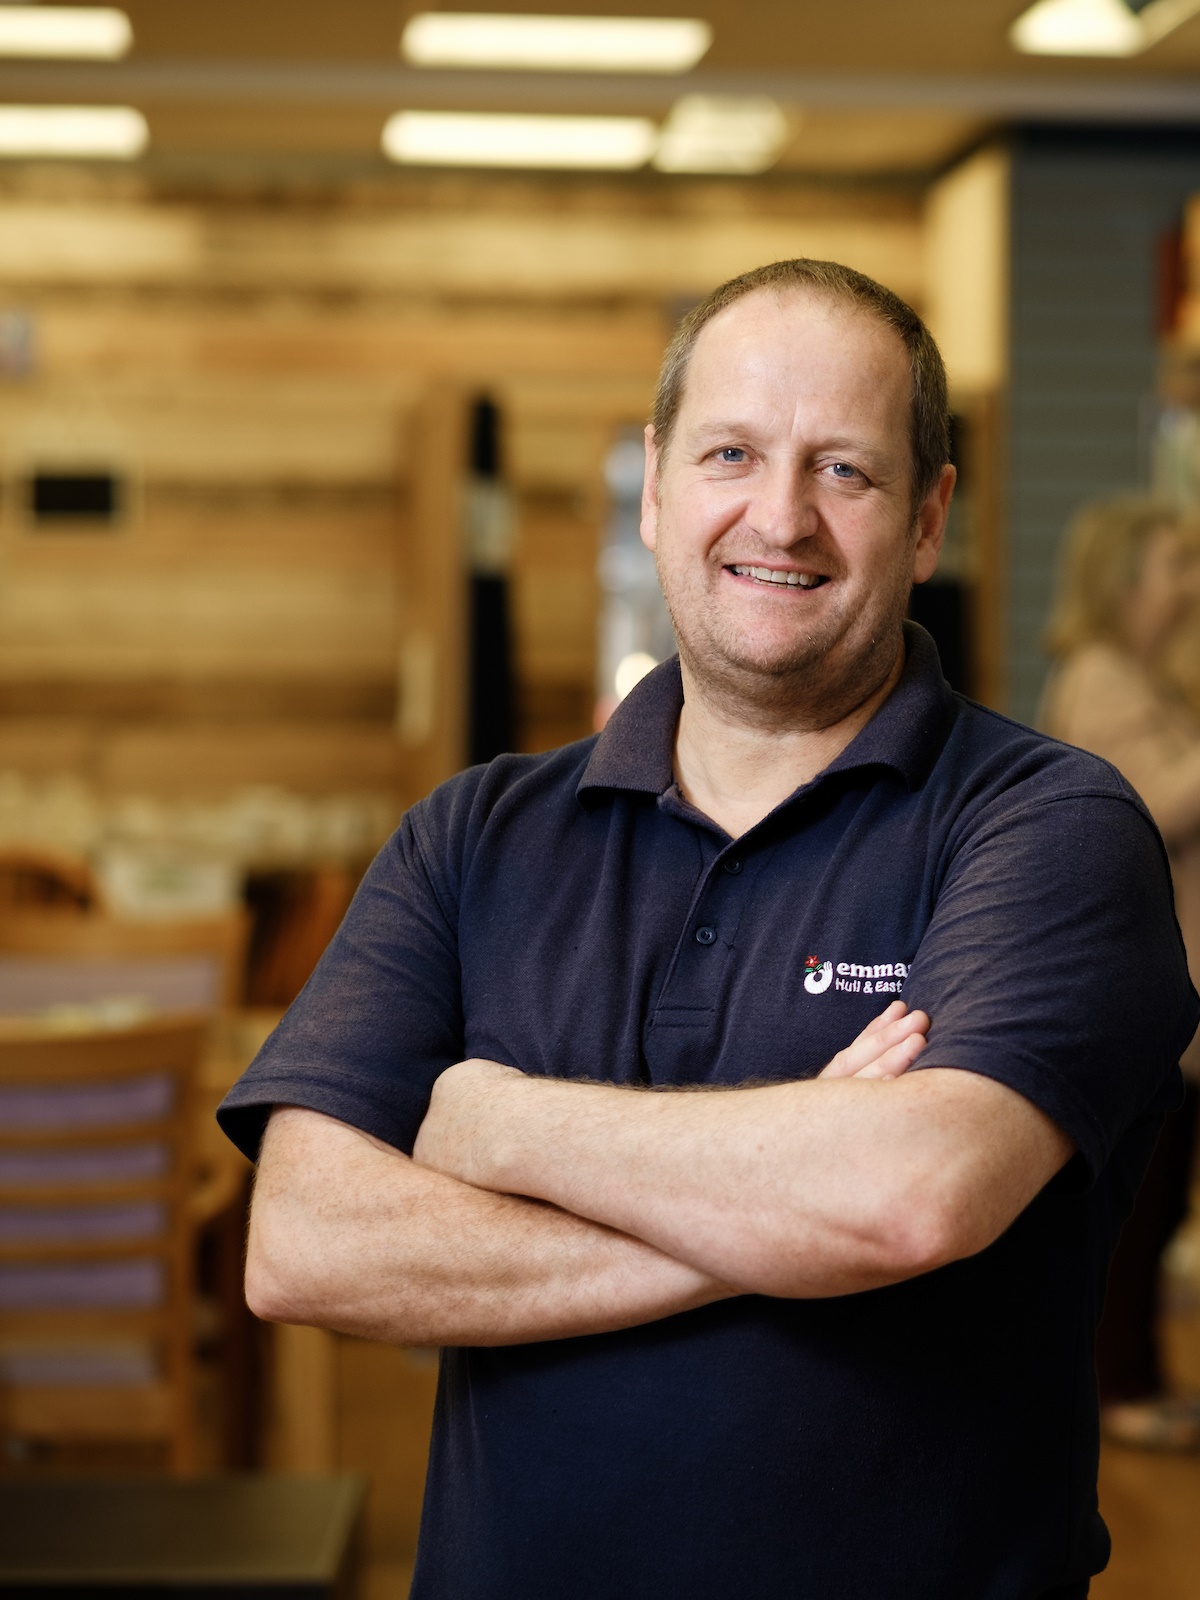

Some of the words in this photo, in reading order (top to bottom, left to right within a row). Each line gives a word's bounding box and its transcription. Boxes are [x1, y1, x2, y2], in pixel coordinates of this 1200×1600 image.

[836, 962, 911, 978] emma
[835, 978, 860, 993] Hull
[863, 981, 873, 994] &
[875, 980, 902, 993] East
